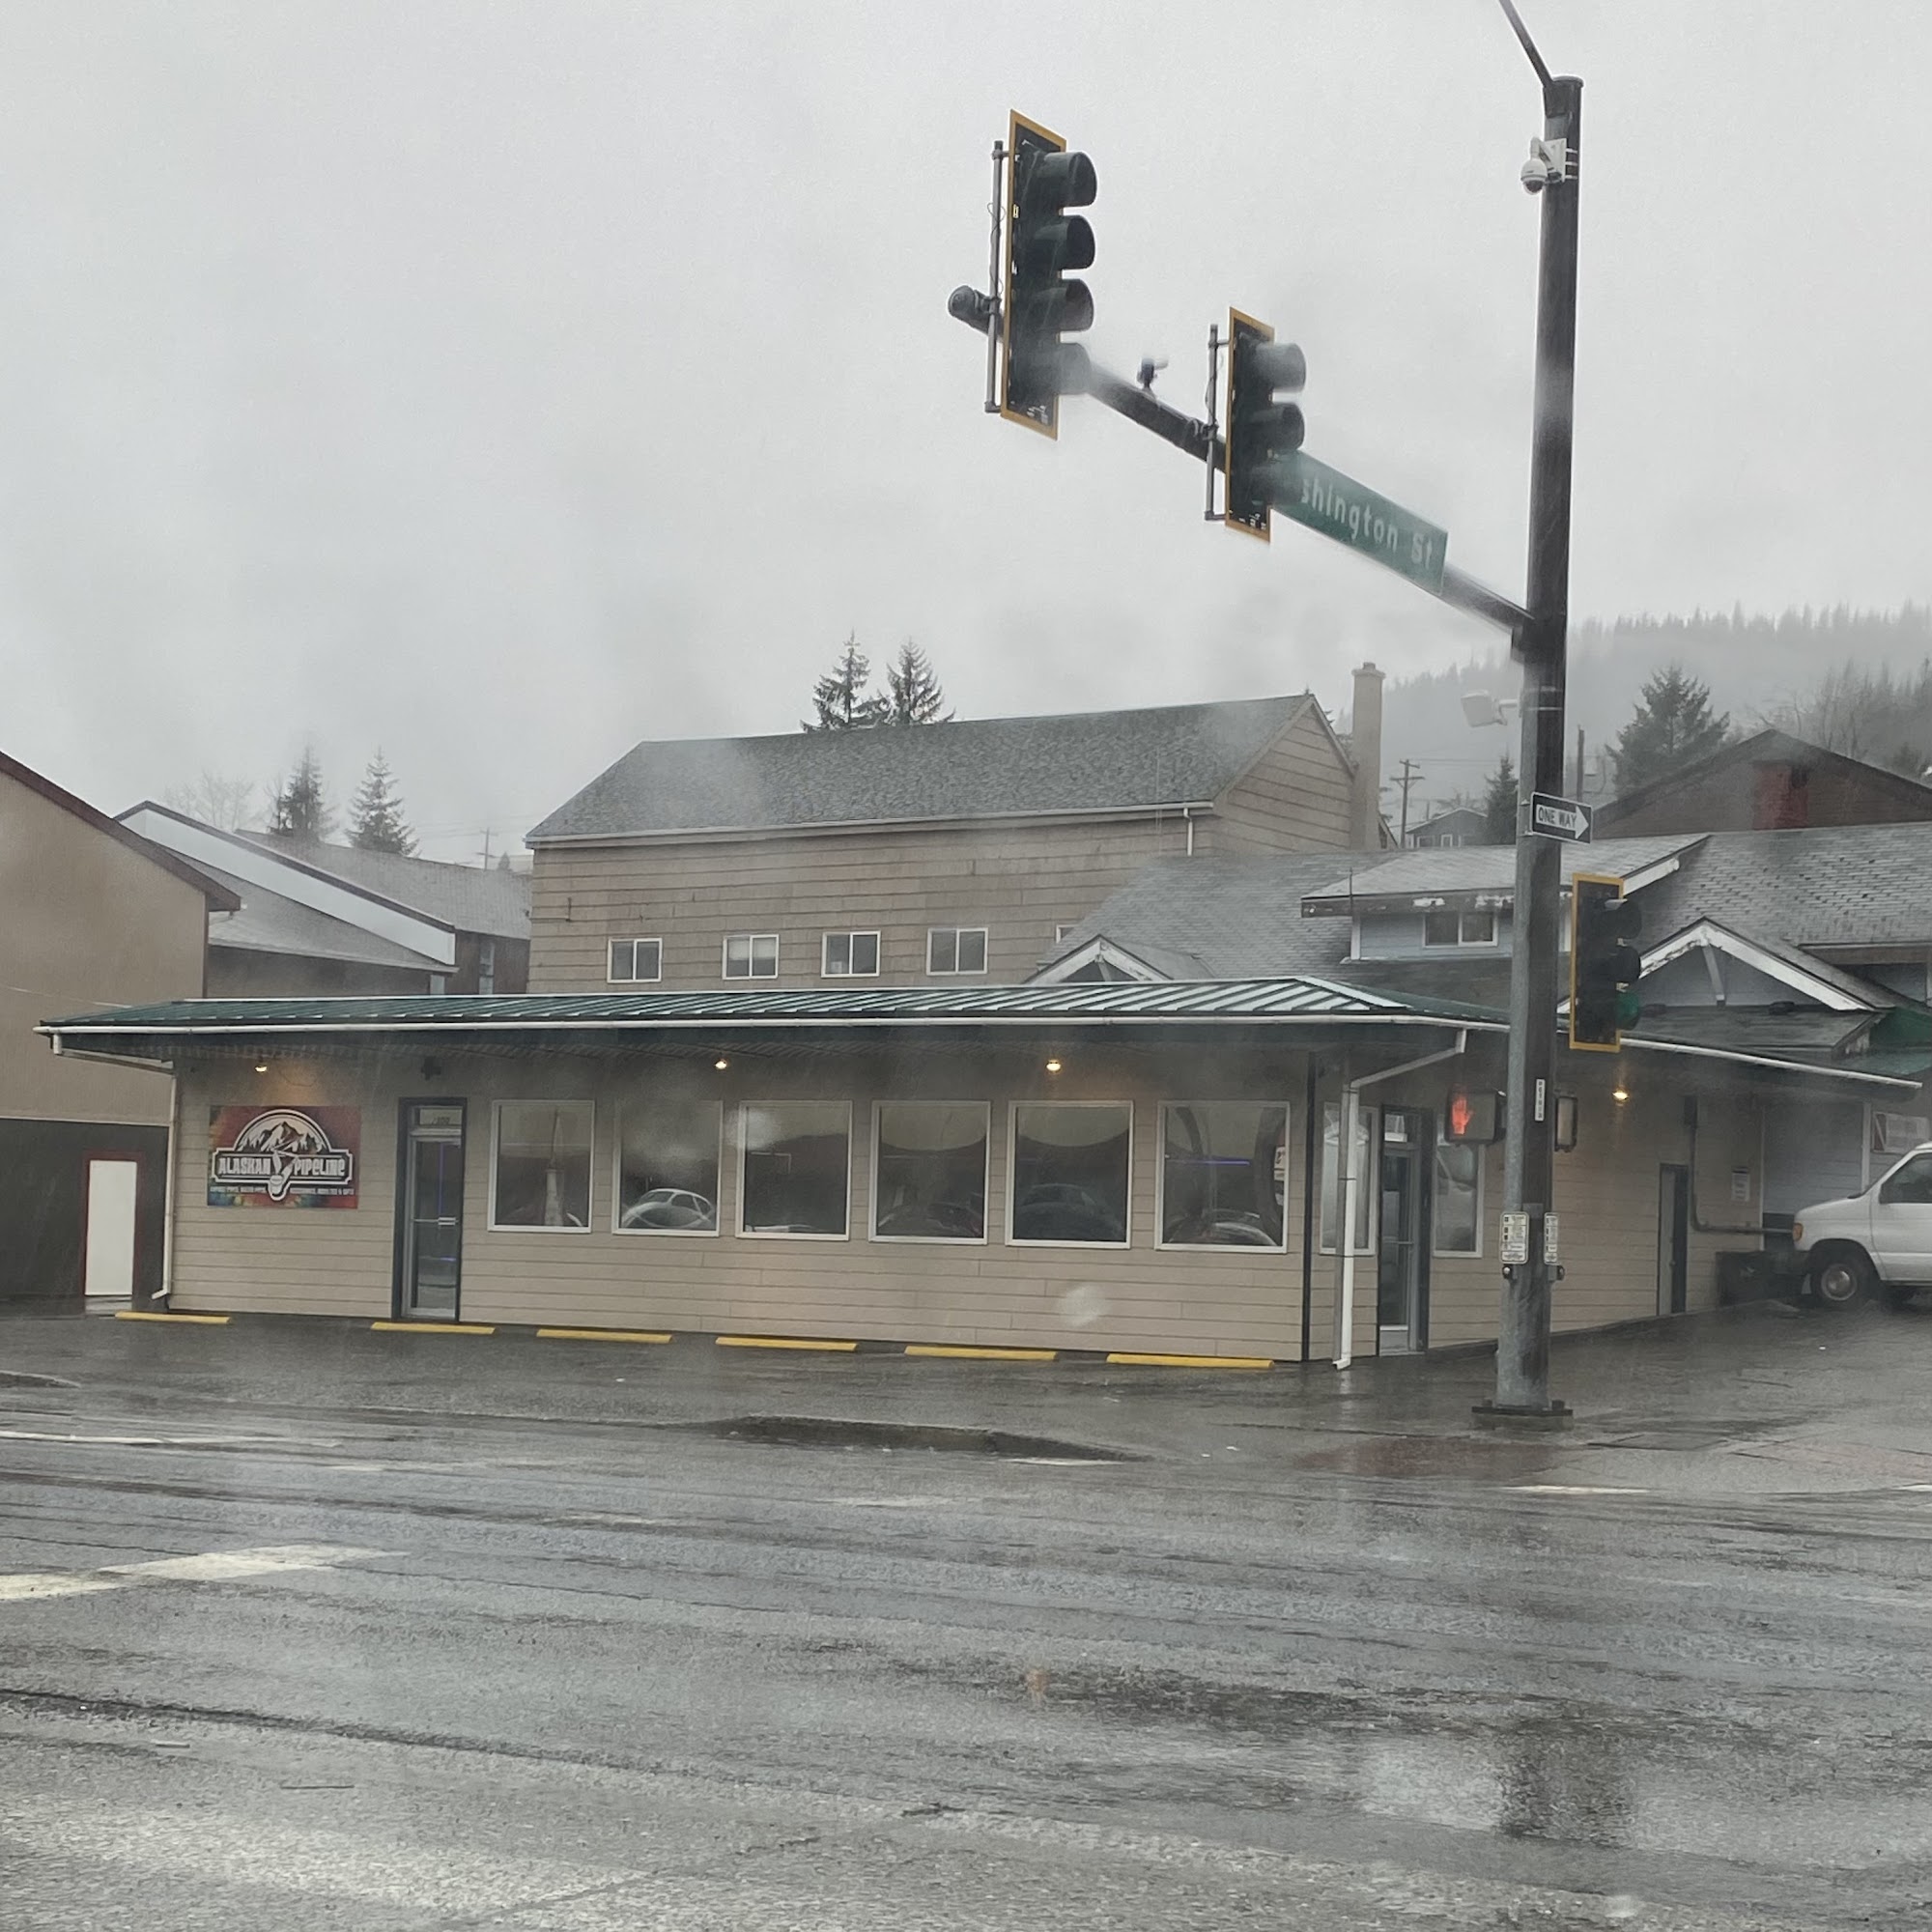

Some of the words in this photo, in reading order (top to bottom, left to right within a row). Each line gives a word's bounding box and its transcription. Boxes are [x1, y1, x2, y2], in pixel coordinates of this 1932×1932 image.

[1300, 475, 1399, 553] shington
[1411, 532, 1433, 570] St
[1538, 806, 1555, 824] ONE
[1558, 811, 1577, 828] WAY
[217, 1157, 270, 1176] ALASKAN
[294, 1157, 345, 1177] PIPELINE
